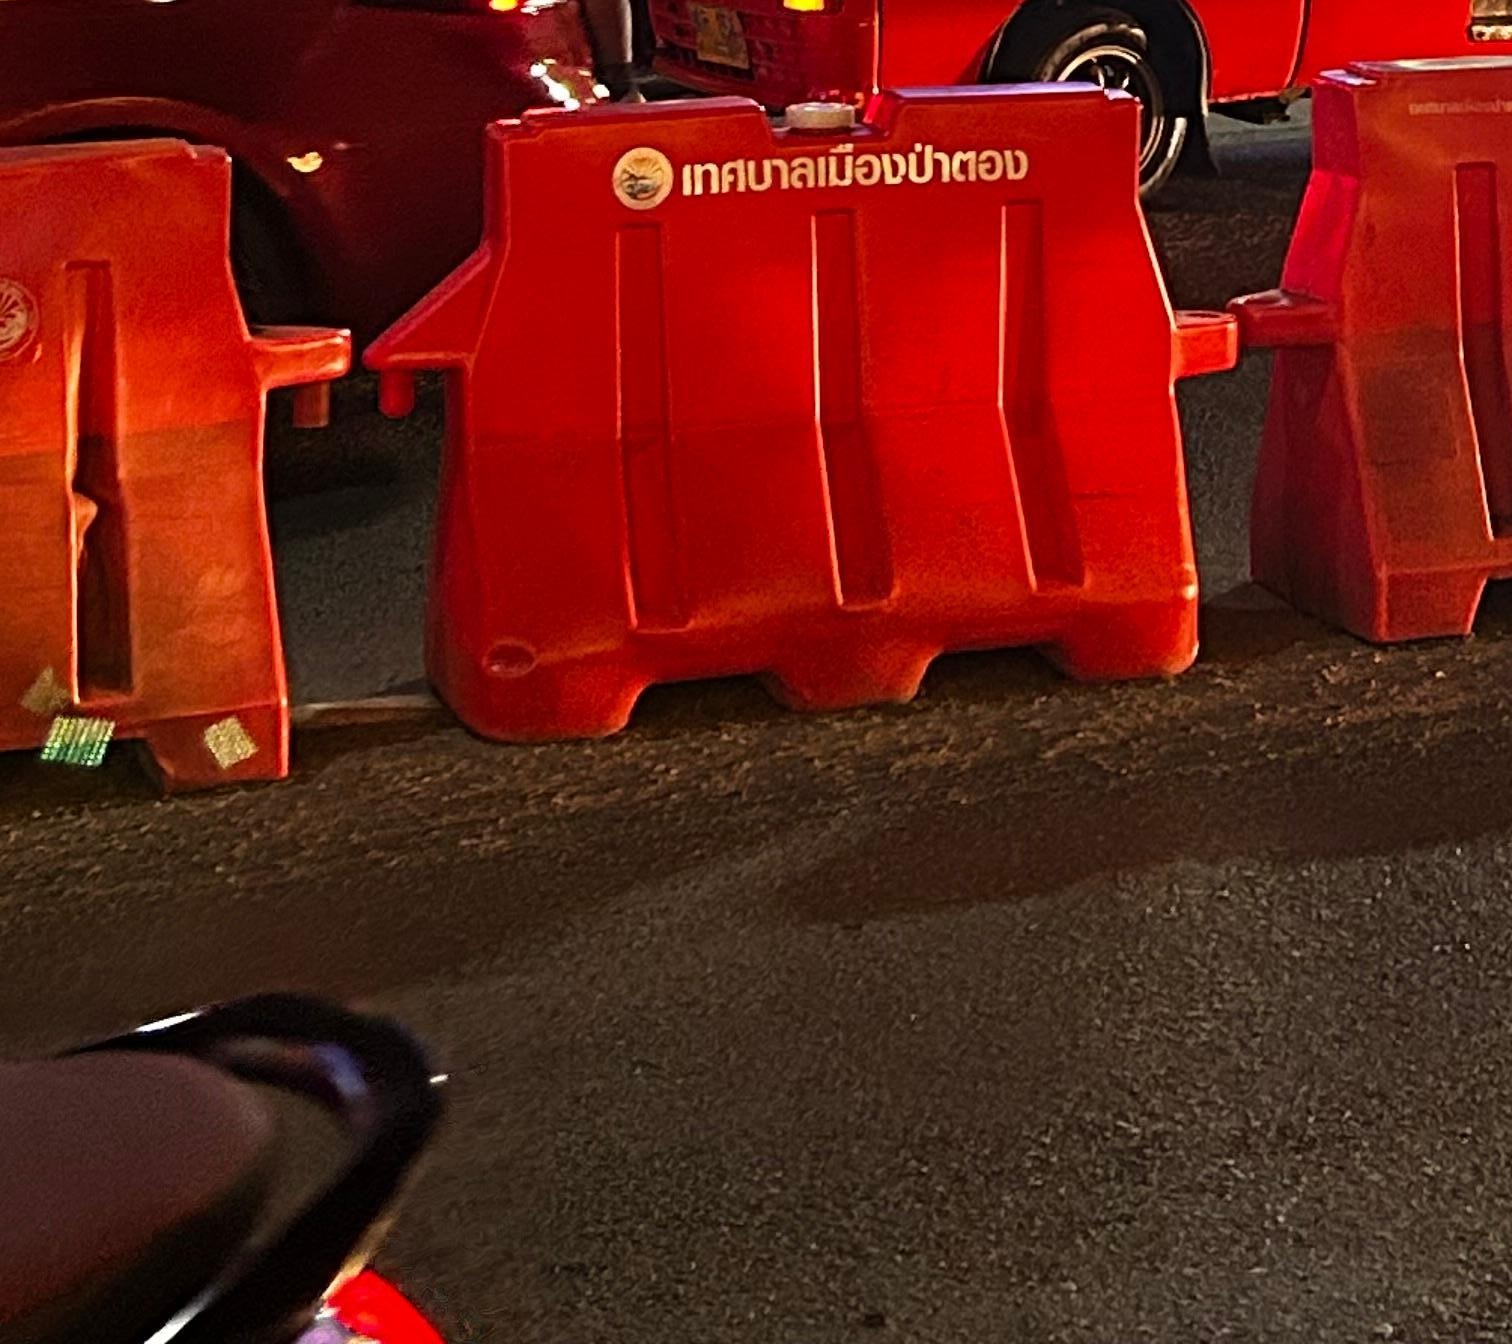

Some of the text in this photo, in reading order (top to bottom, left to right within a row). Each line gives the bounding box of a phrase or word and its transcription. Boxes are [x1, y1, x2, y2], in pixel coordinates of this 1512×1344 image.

[681, 142, 1029, 196] เทศบาลเมืองป่าตอง
